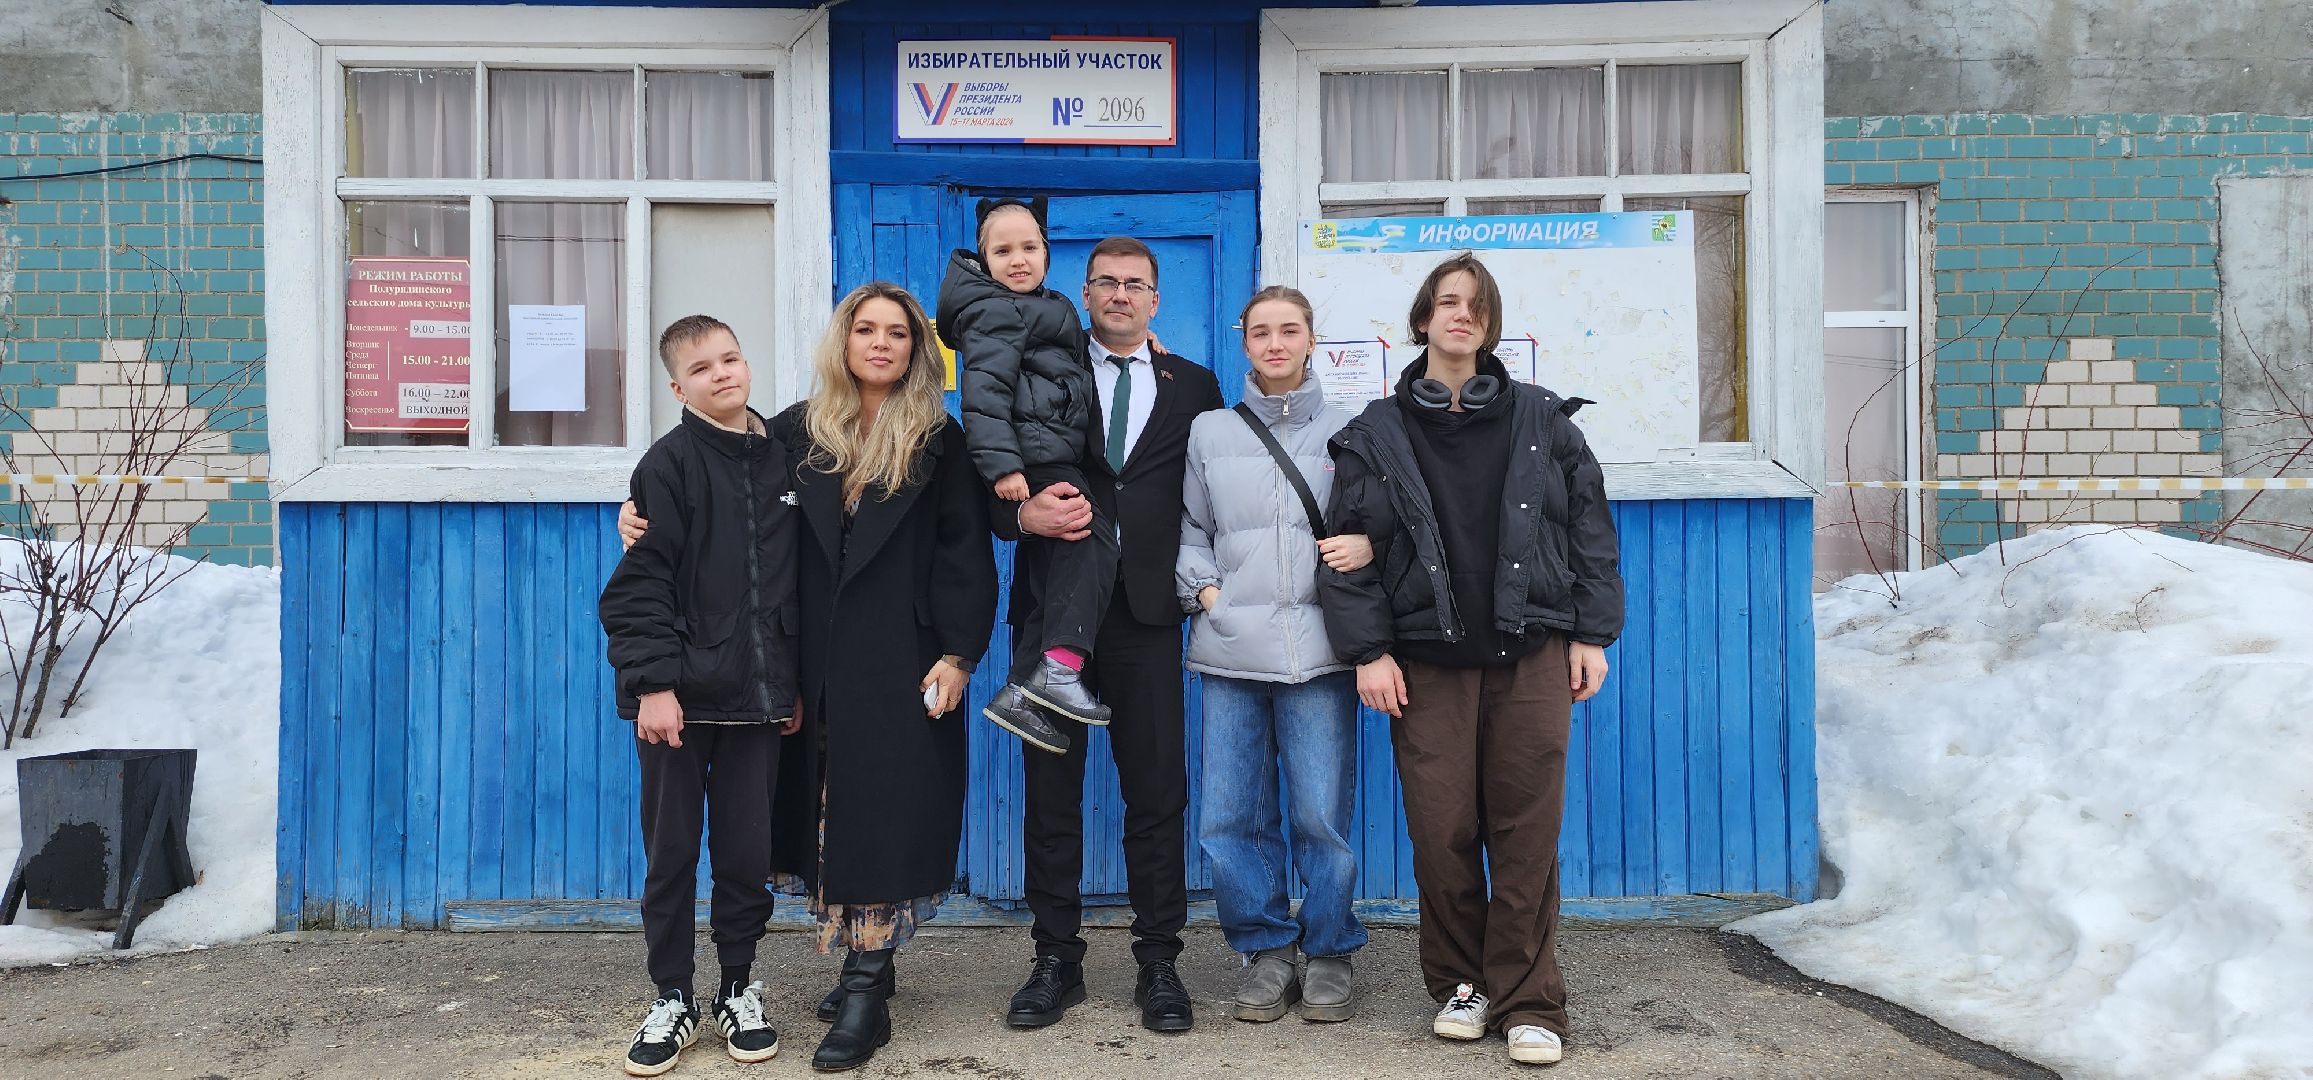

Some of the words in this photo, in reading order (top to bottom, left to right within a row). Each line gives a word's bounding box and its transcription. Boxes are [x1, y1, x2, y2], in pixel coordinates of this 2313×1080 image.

[908, 49, 1070, 69] ИЗБИРАТЕЛЬНЫЙ
[1078, 53, 1163, 70] УЧАСТОК
[963, 82, 1010, 92] ВЫБОРЫ
[959, 94, 1022, 105] ПРЕЗИДЕНТА
[953, 106, 996, 115] РОССИИ
[1098, 96, 1145, 122] 2096
[970, 117, 995, 126] МАРТА
[1418, 221, 1599, 244] ИНФОРМАЦИЯ
[359, 270, 406, 281] РЕЖИМ
[410, 271, 463, 282] РАБОТЫ
[347, 299, 396, 307] сельского
[398, 300, 422, 308] дома
[346, 323, 398, 332] Понедельник
[413, 325, 435, 334] 9.00
[346, 340, 380, 349] Вторник
[345, 351, 369, 360] Среда
[402, 355, 431, 365] 15.00
[441, 356, 471, 366] 21.00
[345, 371, 380, 380] Пятница
[345, 388, 378, 398] Суббота
[402, 387, 431, 397] 16.00
[406, 404, 468, 415] ВЫХОДНОЙ
